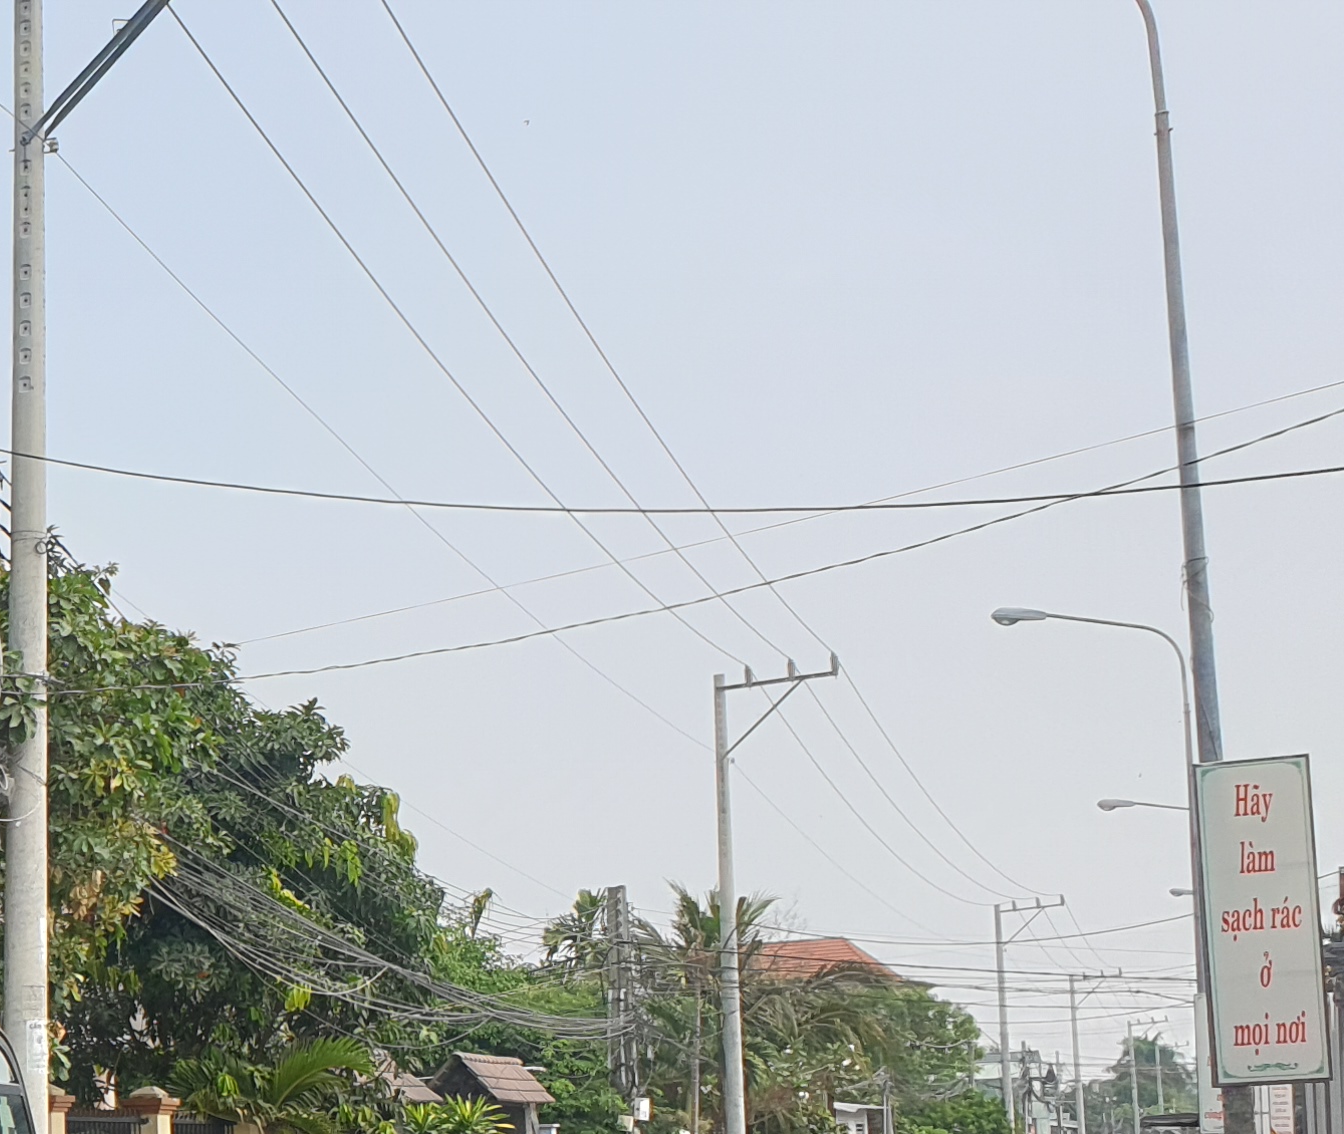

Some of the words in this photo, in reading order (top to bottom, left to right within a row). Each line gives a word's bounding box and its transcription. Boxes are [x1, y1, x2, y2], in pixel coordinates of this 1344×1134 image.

[1234, 784, 1273, 823] Hãy
[1239, 841, 1276, 874] làm
[1221, 897, 1265, 942] sạch
[1270, 896, 1302, 929] rác
[1260, 950, 1272, 988] ở
[1233, 1012, 1270, 1056] mọi
[1275, 1010, 1307, 1044] nơi
